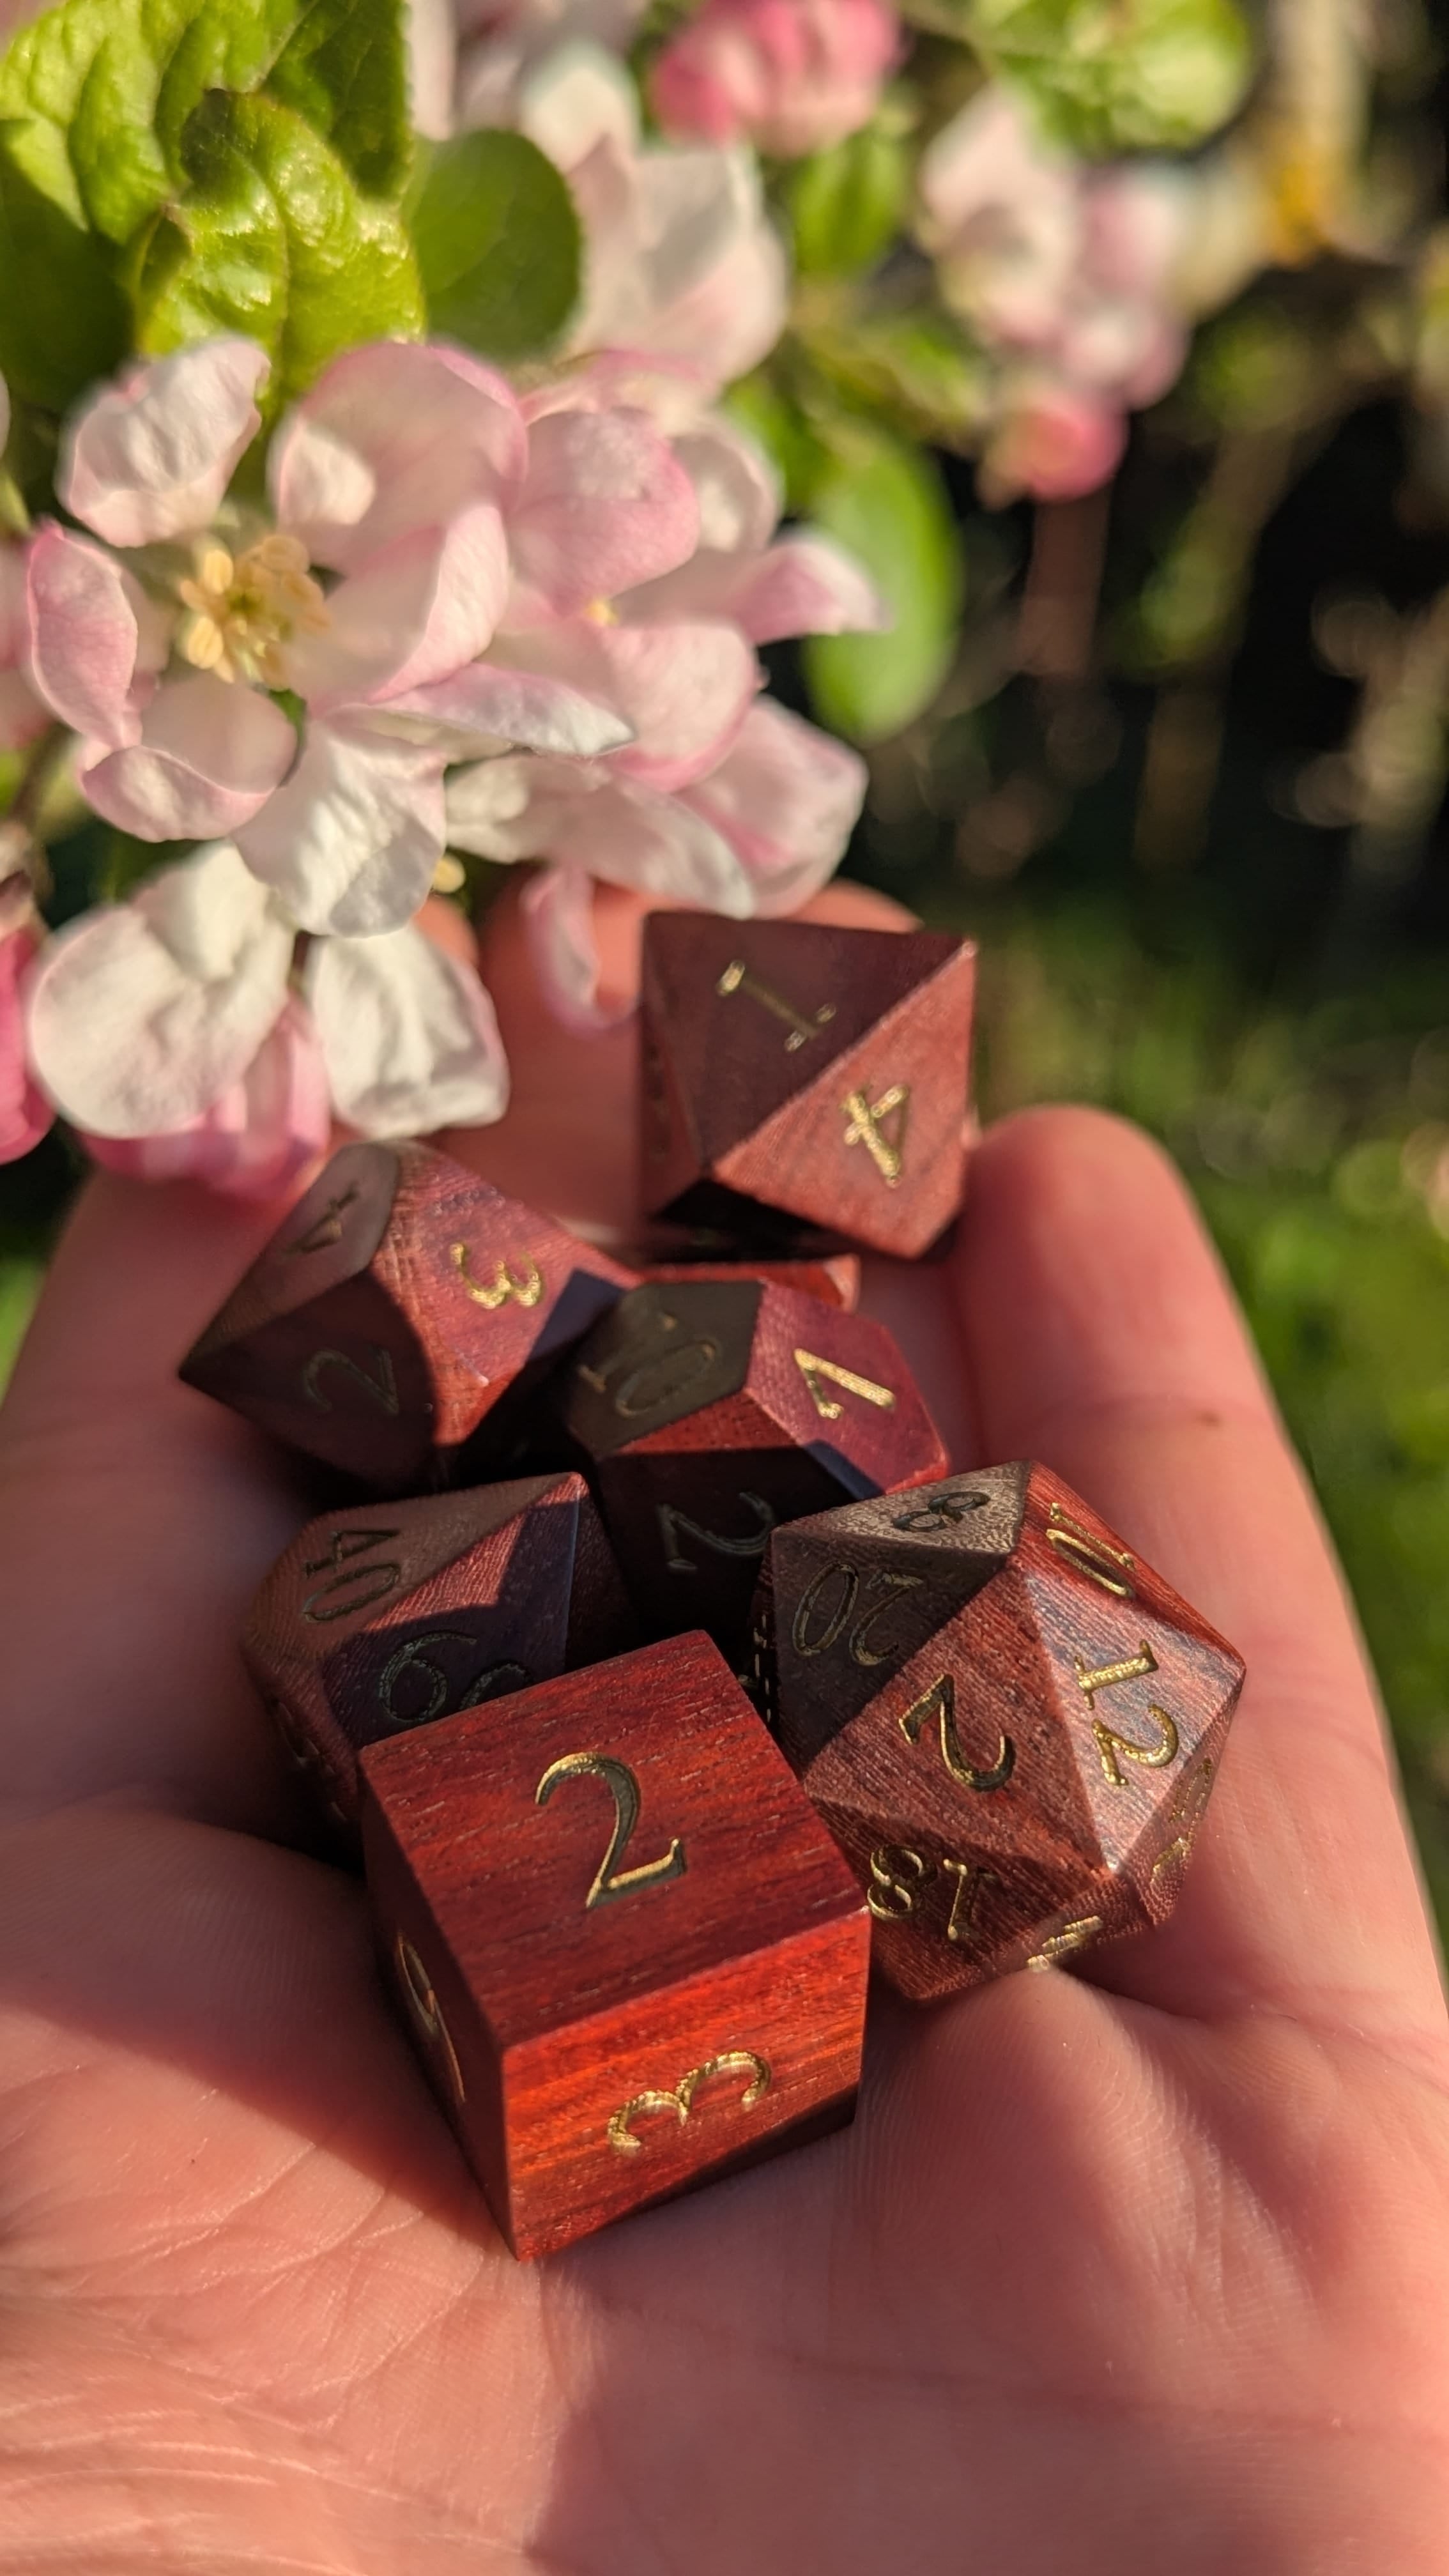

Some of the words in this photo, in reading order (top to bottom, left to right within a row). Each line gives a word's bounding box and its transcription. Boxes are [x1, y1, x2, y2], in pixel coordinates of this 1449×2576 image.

[716, 960, 836, 1052] 1
[839, 1085, 908, 1188] 4
[450, 1242, 543, 1310] 3
[301, 1346, 399, 1416] 2
[576, 1311, 722, 1418] 10
[657, 1491, 778, 1570] 2
[891, 1491, 992, 1533] 8
[1046, 1501, 1136, 1598] 10
[302, 1529, 402, 1623] 40
[790, 1558, 925, 1667] 20
[898, 1673, 1016, 1791] 2
[1073, 1639, 1179, 1787] 12
[534, 1751, 688, 1910] 2
[866, 1843, 1002, 1942] 18
[606, 2050, 771, 2158] 3
